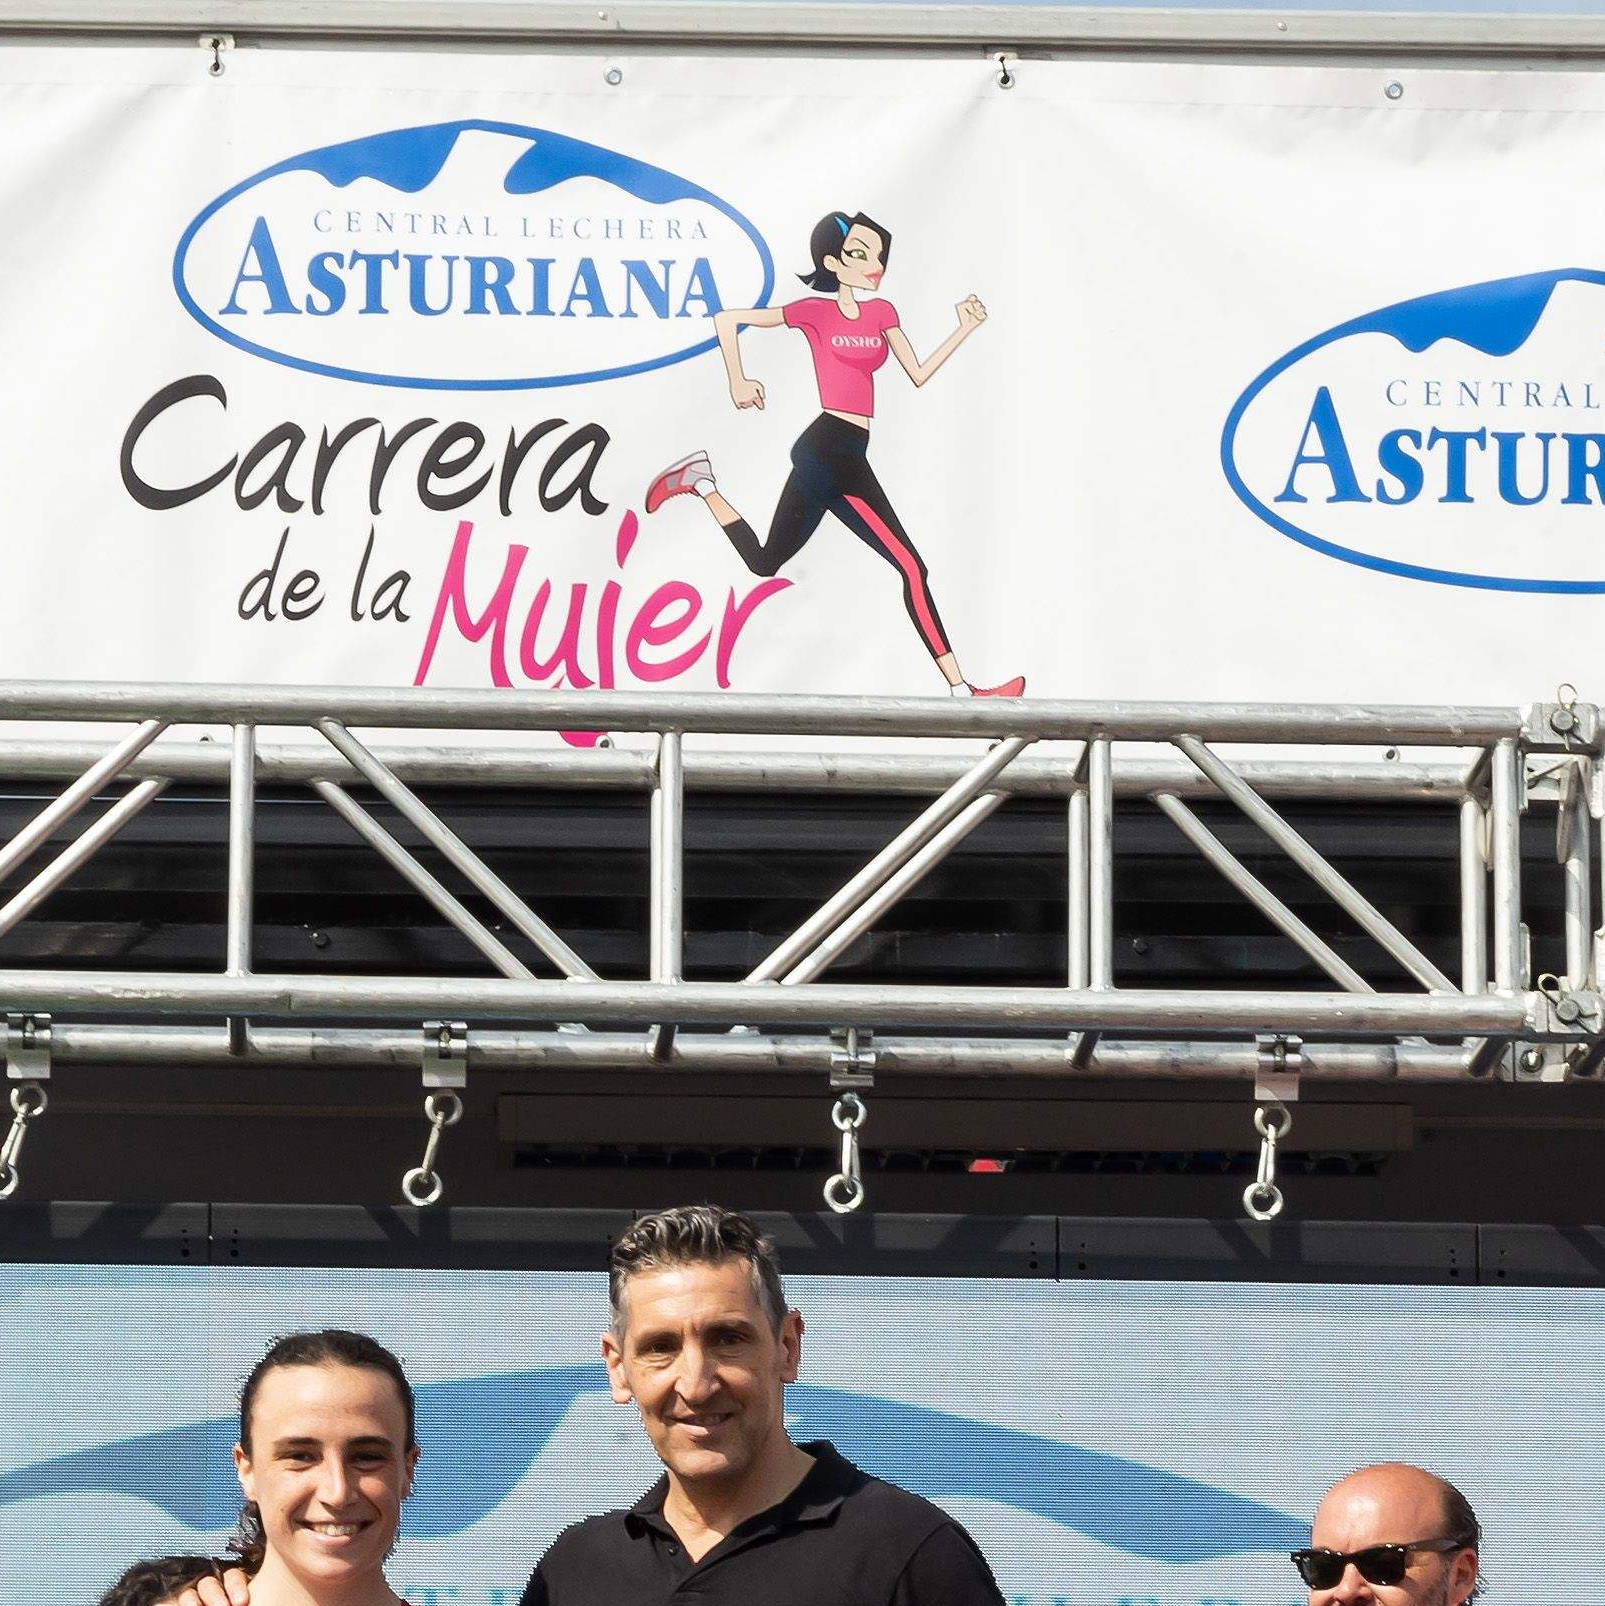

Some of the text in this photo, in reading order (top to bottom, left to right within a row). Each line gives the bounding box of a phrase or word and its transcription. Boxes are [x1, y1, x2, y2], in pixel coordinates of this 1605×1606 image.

[313, 211, 708, 241] CENTRAL LECHERA
[219, 215, 724, 321] ASTURIANA
[831, 335, 882, 348] OYSHO
[1385, 379, 1601, 410] CENTRAL
[120, 375, 612, 517] Carrera
[238, 508, 795, 748] de la Mujer
